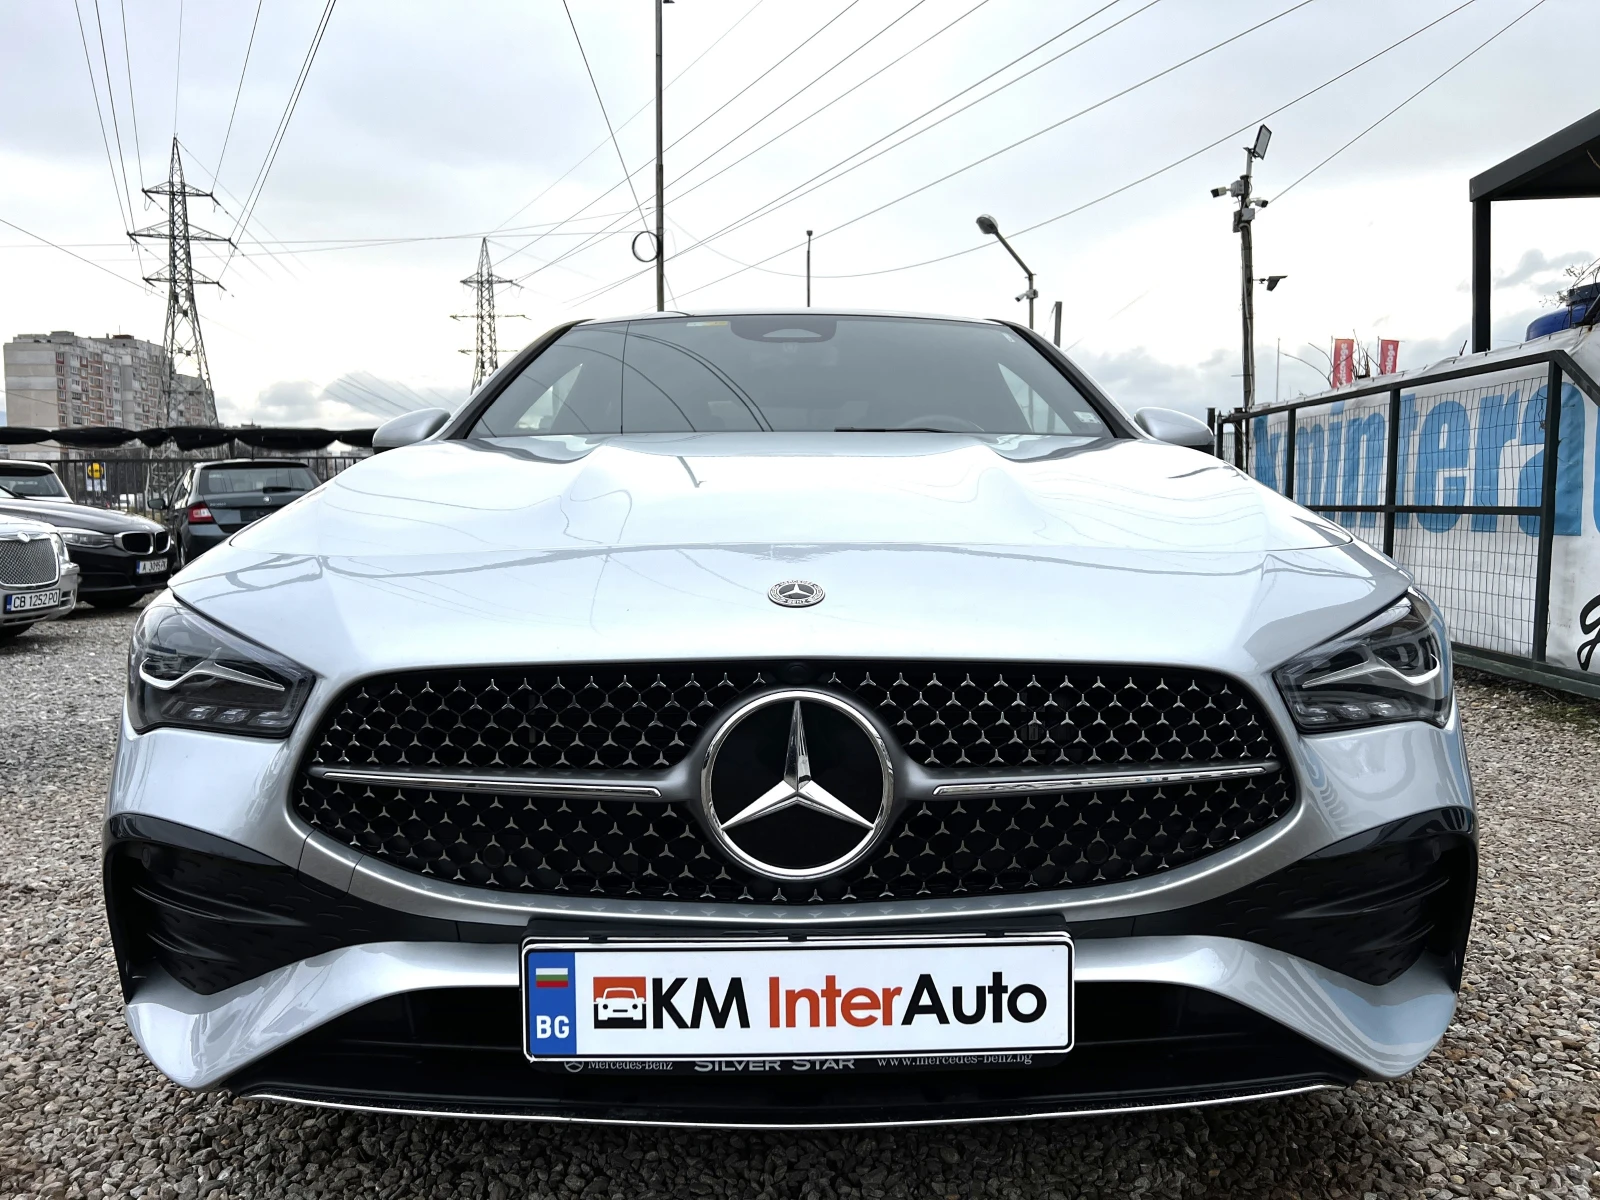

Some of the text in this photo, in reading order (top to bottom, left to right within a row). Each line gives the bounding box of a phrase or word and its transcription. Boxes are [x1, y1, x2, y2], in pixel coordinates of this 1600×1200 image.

[13, 595, 26, 609] CB
[652, 971, 1047, 1030] KM InterAuto
[536, 1015, 570, 1039] BG
[588, 1060, 673, 1070] Mercedes-Benz
[877, 1053, 1033, 1067] www.mercedes-benz.bg
